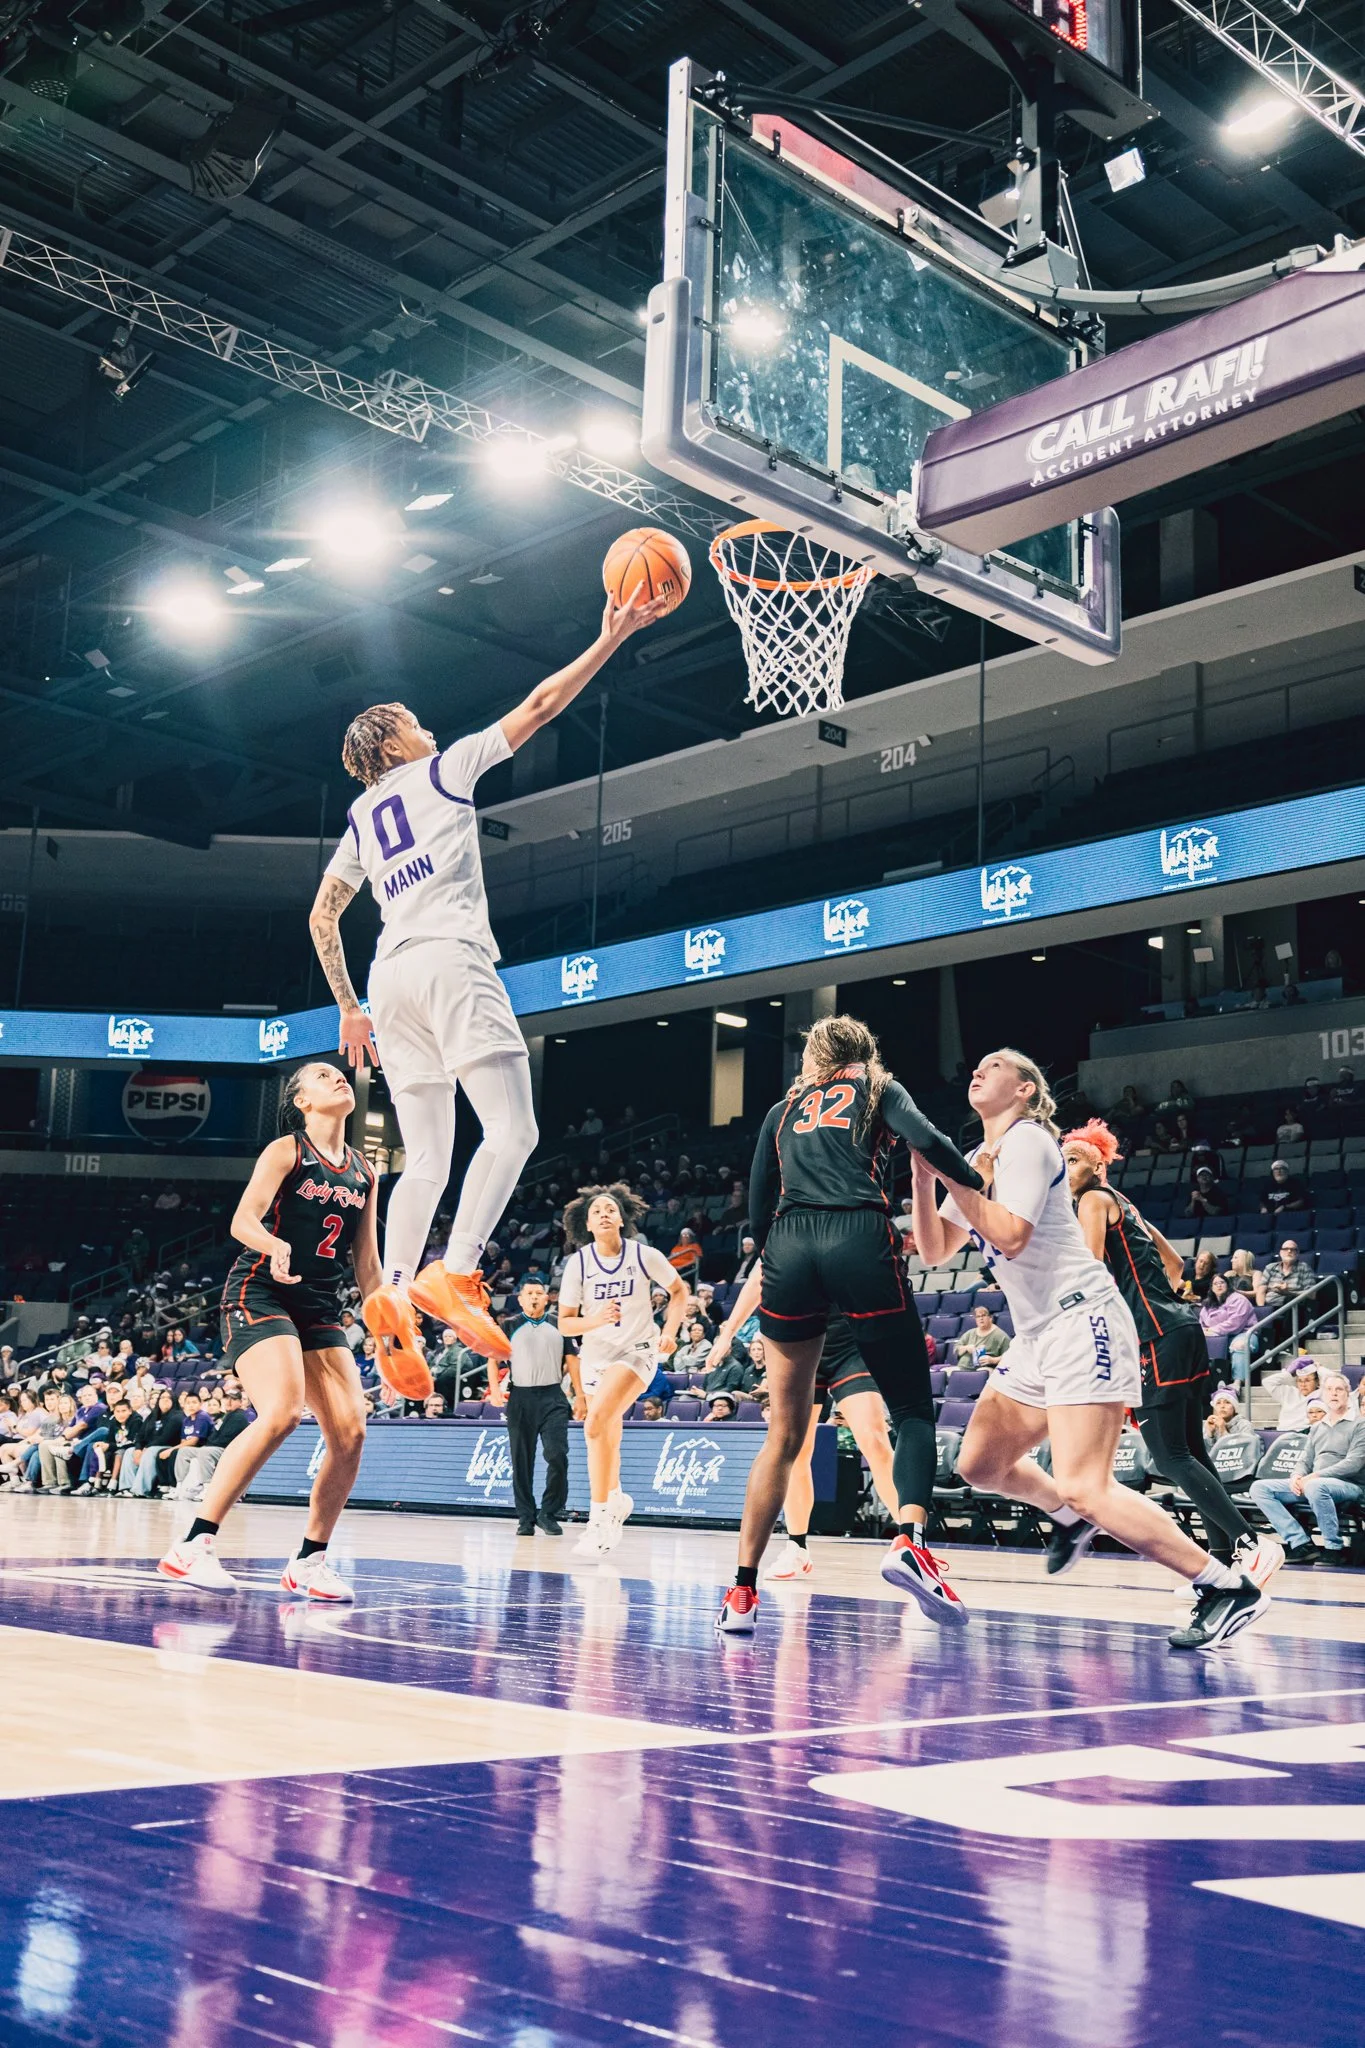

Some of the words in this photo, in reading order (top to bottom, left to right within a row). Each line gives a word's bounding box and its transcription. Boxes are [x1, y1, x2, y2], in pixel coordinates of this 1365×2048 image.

[1026, 394, 1135, 464] CALL
[1144, 336, 1268, 422] RAFI!
[1030, 435, 1135, 487] ACCIDENT
[1144, 387, 1257, 444] ATTORNEY
[880, 743, 917, 774] 204
[371, 794, 416, 861] 0
[602, 819, 632, 847] 205
[384, 854, 435, 902] MANN
[1318, 1027, 1365, 1060] 103
[127, 1090, 206, 1111] PEPSI
[793, 1084, 856, 1134] 32
[64, 1154, 100, 1173] 106
[296, 1178, 334, 1205] Lady
[316, 1213, 344, 1259] 2
[594, 1279, 634, 1300] GCU
[1089, 1315, 1113, 1381] LOPES
[1112, 1459, 1136, 1467] LOBAL
